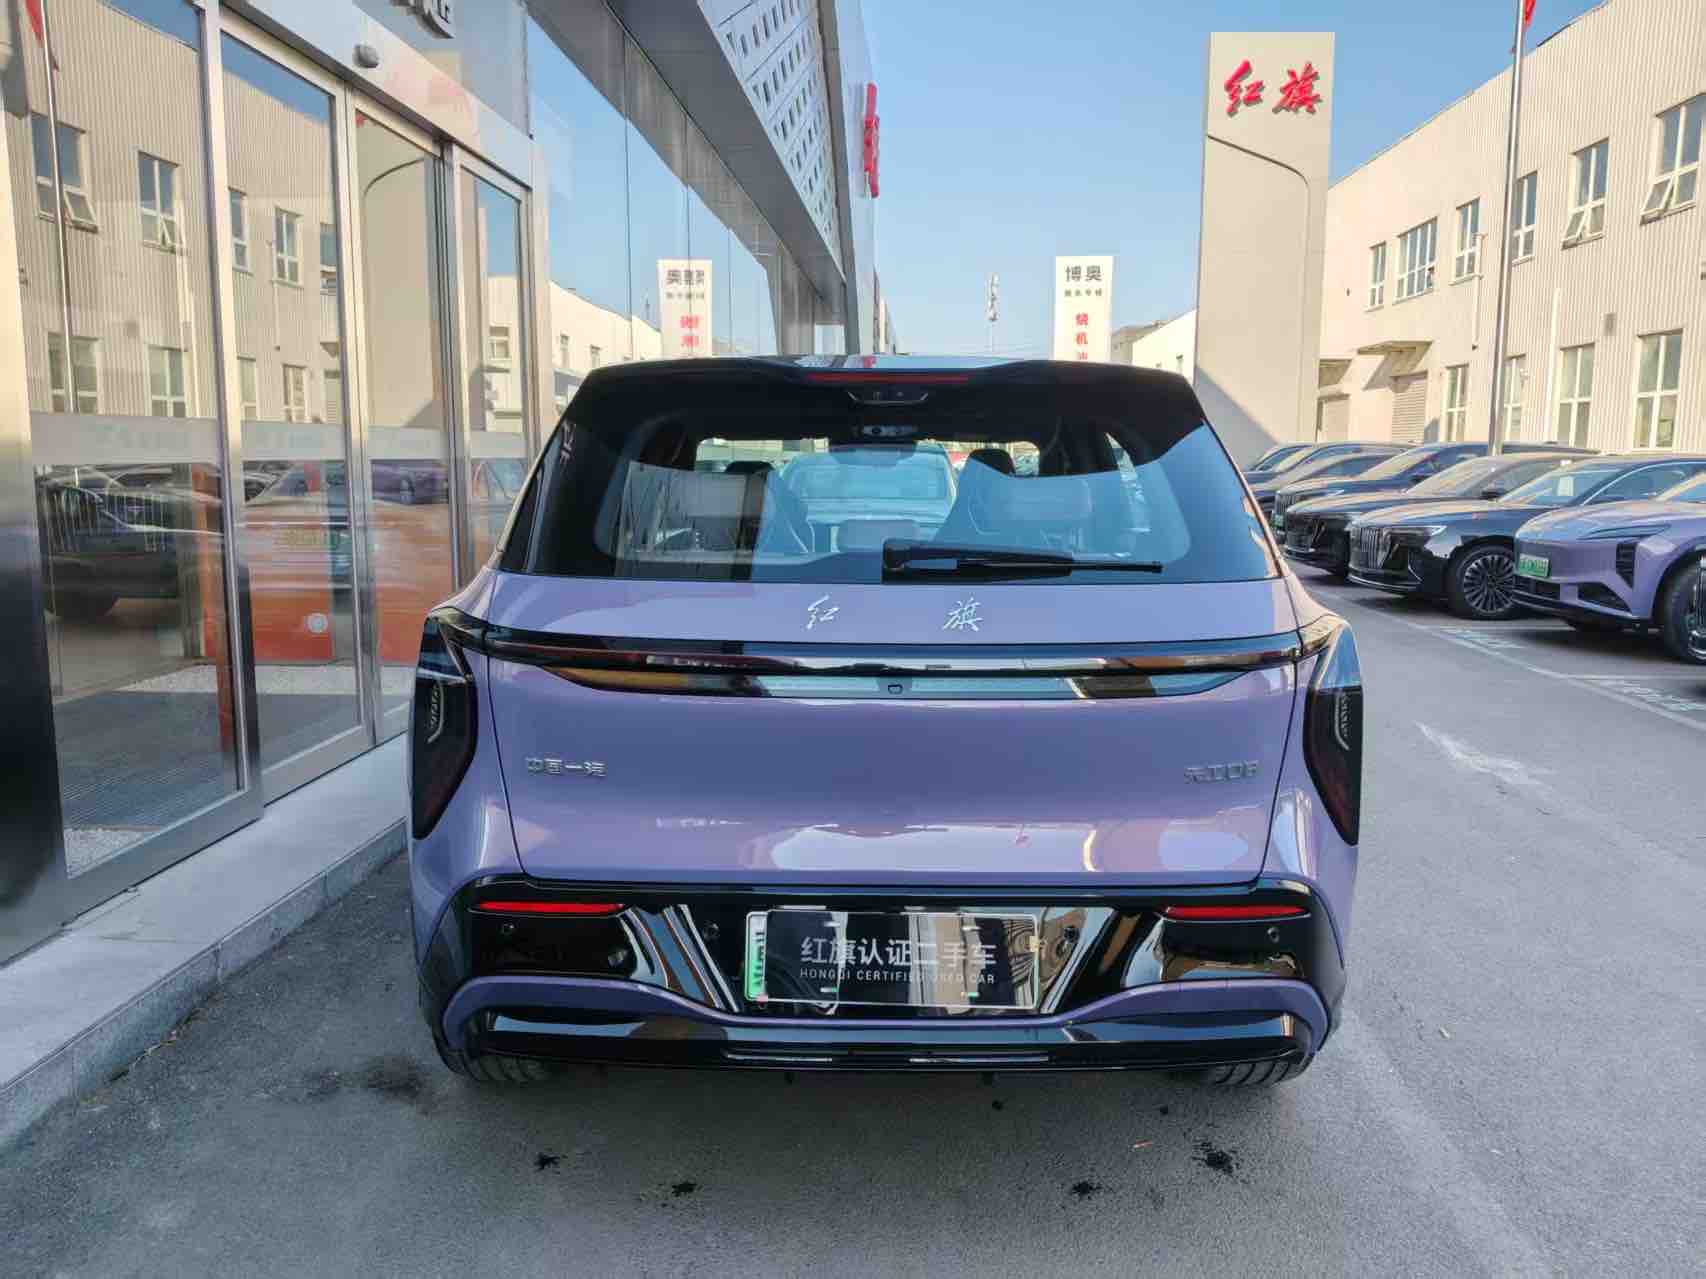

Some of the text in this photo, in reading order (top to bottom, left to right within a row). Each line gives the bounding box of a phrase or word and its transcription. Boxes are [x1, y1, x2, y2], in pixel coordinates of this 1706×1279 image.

[1223, 59, 1323, 118] 红旗
[1065, 265, 1103, 283] 博奥
[805, 594, 984, 633] 红旗
[800, 935, 997, 968] 红旗认证二手车
